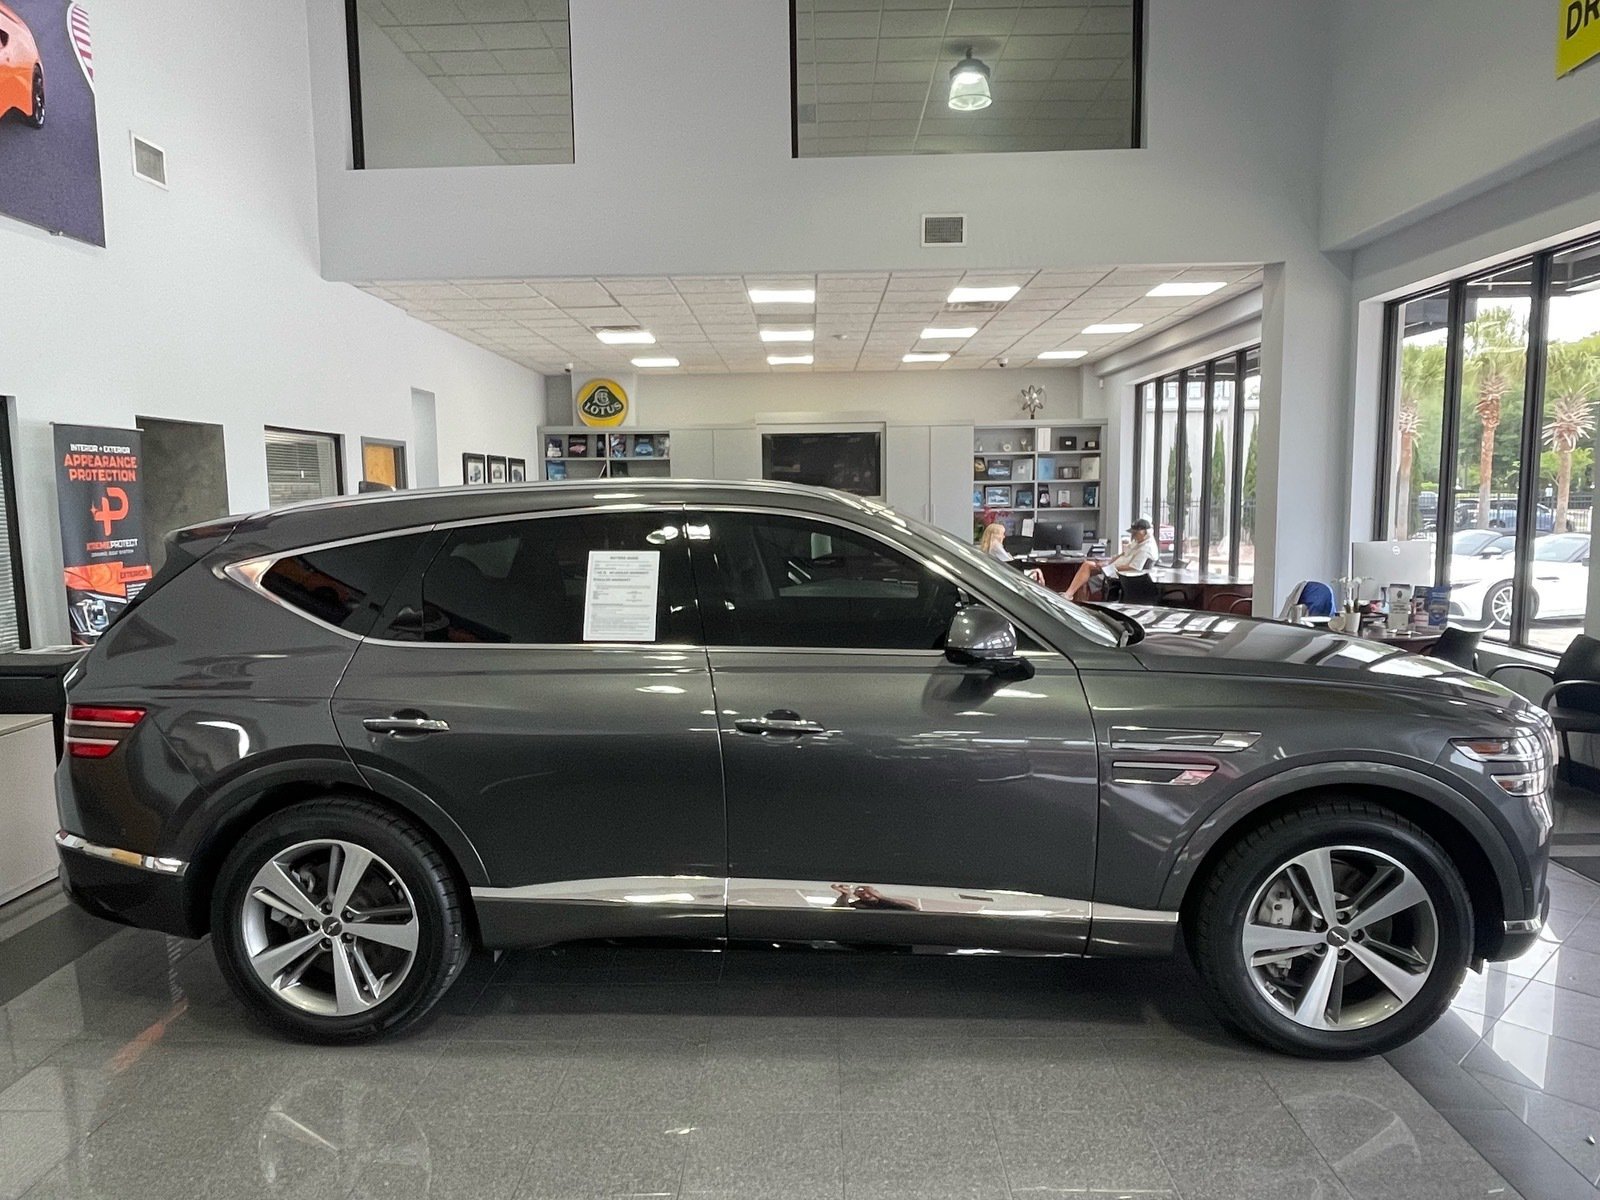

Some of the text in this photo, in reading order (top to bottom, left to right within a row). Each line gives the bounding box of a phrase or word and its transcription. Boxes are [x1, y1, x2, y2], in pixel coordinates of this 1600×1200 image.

[584, 402, 622, 415] LOTUS
[70, 443, 98, 452] INTERIOR
[103, 446, 131, 454] EXTERIOR
[64, 454, 138, 468] APPEARANCE
[69, 469, 137, 481] PROTECTION
